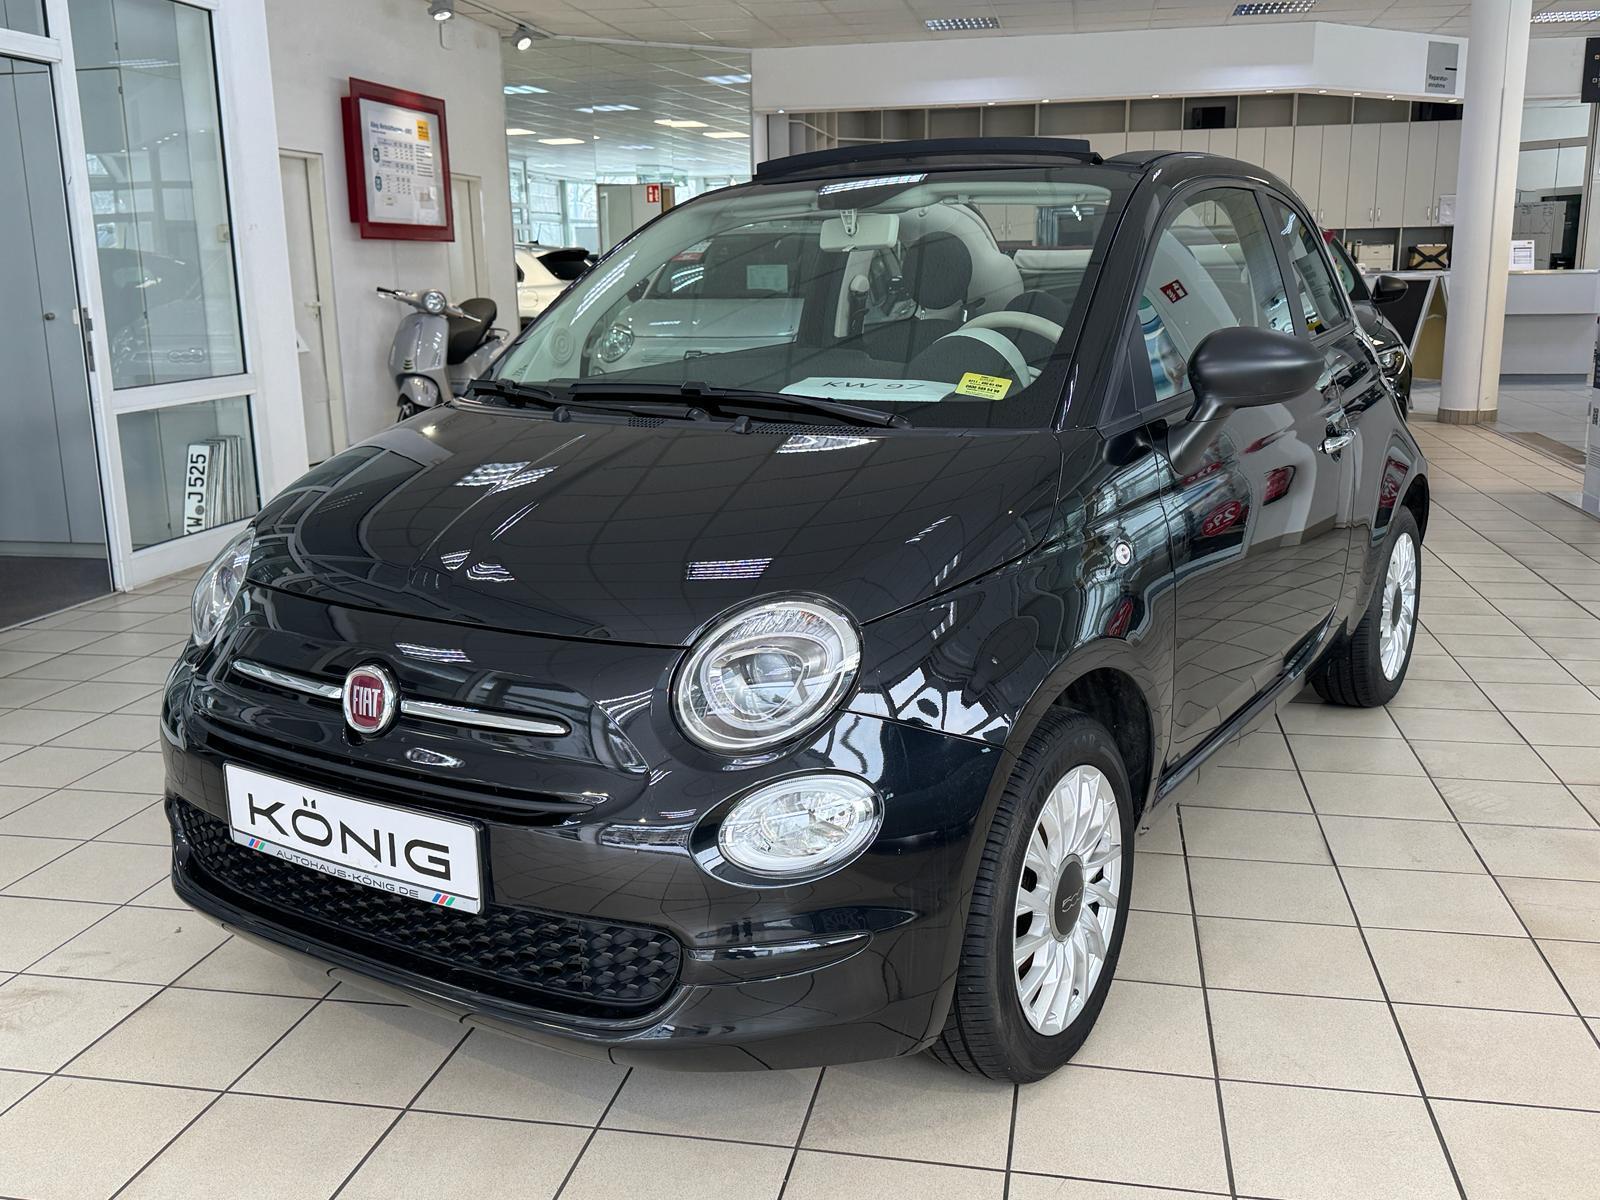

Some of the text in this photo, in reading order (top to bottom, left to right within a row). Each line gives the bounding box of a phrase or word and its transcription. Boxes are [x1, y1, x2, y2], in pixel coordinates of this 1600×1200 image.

[822, 381, 878, 389] KW
[352, 685, 382, 718] FIAT
[247, 792, 452, 882] KÖNIG
